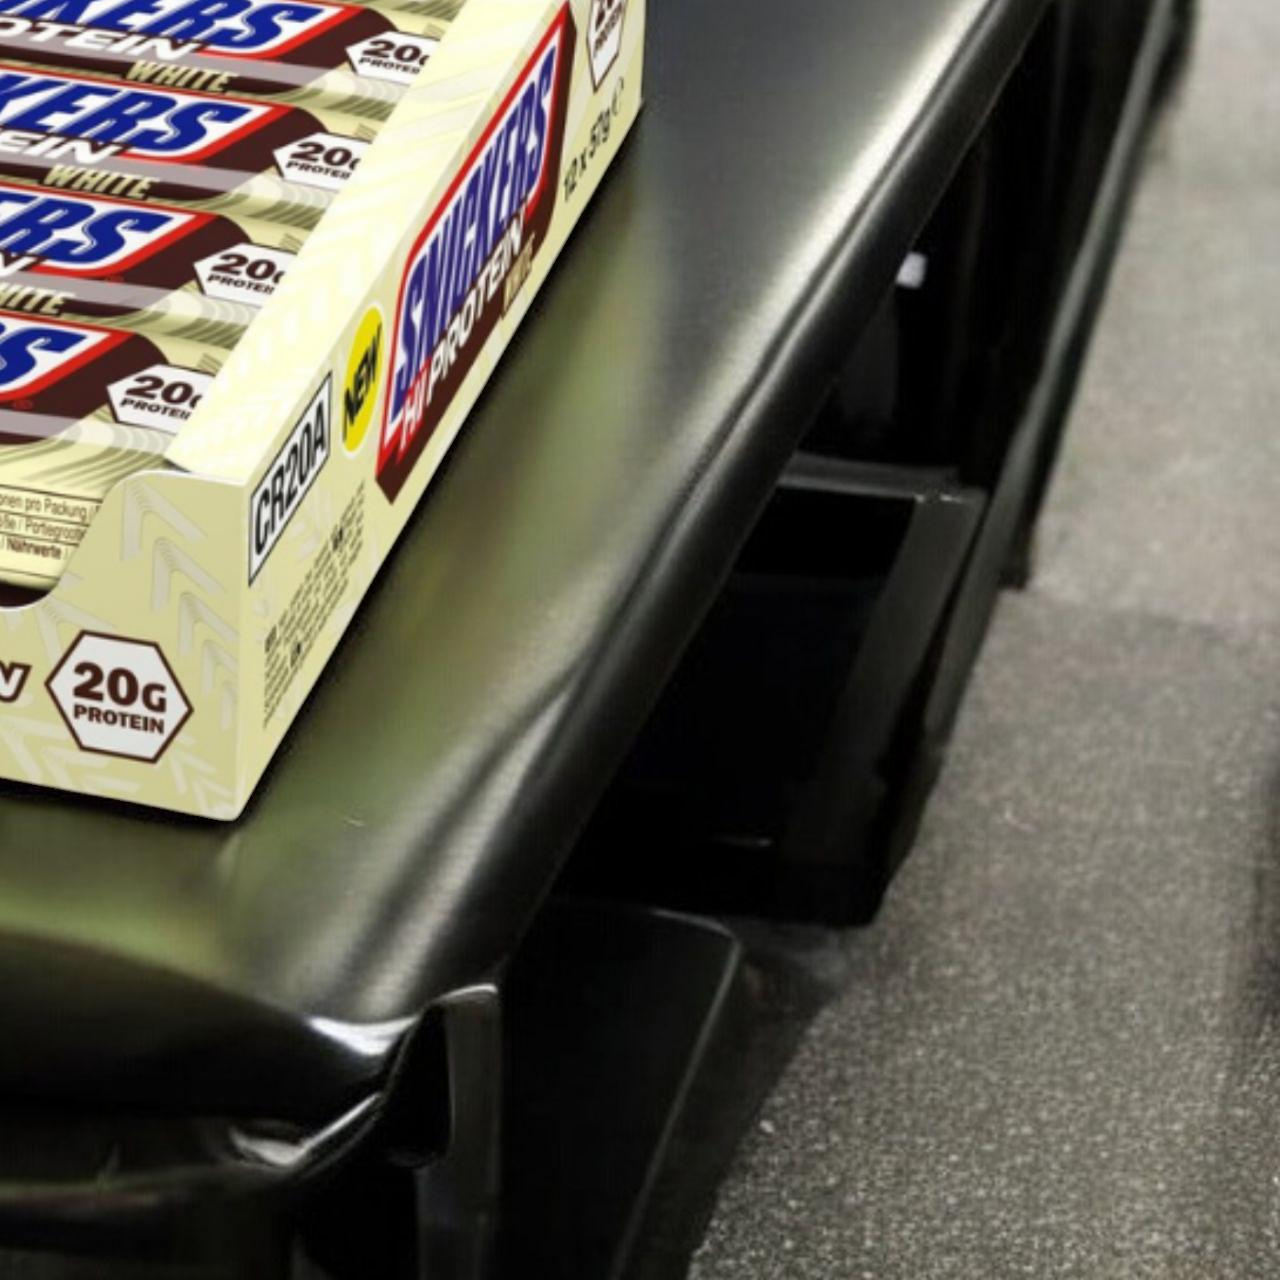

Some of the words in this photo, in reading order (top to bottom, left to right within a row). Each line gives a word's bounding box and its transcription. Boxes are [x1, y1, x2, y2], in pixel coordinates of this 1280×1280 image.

[125, 59, 240, 93] WHITE
[42, 163, 161, 200] WHITE
[391, 45, 556, 424] SNICKERS
[426, 206, 526, 407] PROTEIN
[344, 322, 383, 440] NEW
[254, 399, 327, 558] CR20A
[25, 497, 42, 513] pro
[43, 497, 87, 524] Packung
[72, 661, 168, 715] 20G
[72, 703, 166, 735] PROTEIN
